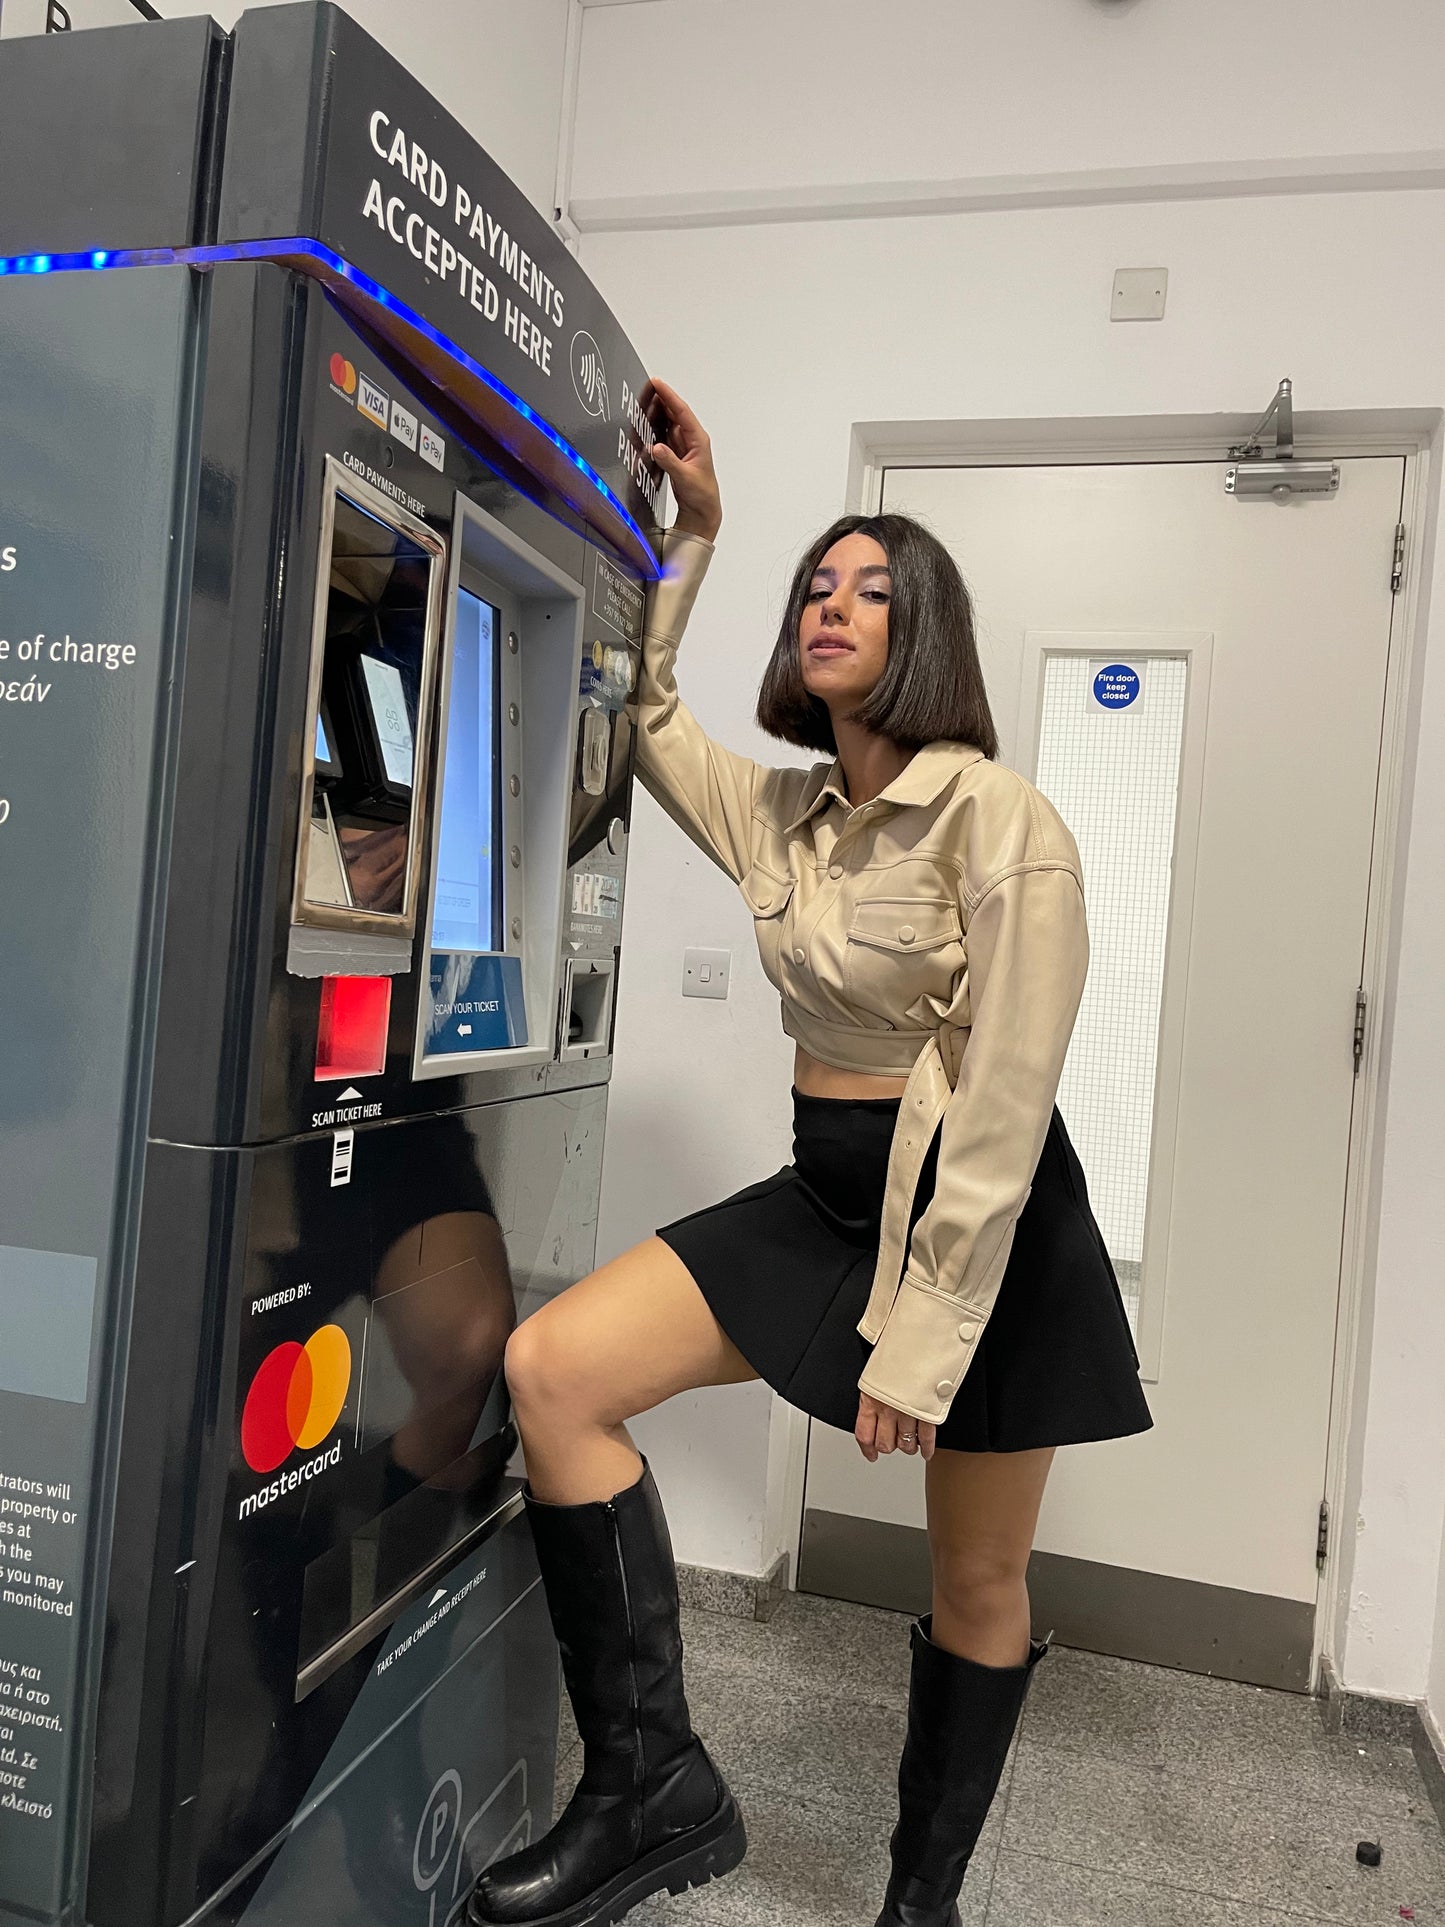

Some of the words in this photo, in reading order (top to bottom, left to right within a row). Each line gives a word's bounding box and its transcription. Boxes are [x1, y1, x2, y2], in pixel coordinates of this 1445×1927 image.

[369, 110, 448, 207] CARD
[454, 184, 564, 327] PAYMENTS
[362, 178, 499, 322] ACCEPTED
[504, 298, 552, 377] HERE
[363, 387, 385, 418] VISA
[400, 417, 415, 440] Pay
[618, 427, 637, 476] PAY
[343, 451, 365, 476] CARD
[366, 467, 407, 504] PAYMENTS
[407, 495, 426, 518] HERE
[18, 634, 45, 660] of
[50, 635, 137, 670] charge
[1098, 674, 1114, 682] Fire
[1116, 674, 1136, 682] door
[1106, 683, 1127, 692] keep
[1102, 692, 1130, 700] closed
[434, 1003, 452, 1015] SCAN
[453, 1002, 473, 1014] YOUR
[473, 1000, 499, 1012] TICKET
[312, 1112, 334, 1127] SCAN
[336, 1106, 362, 1122] TICKET
[363, 1102, 383, 1117] HERE
[251, 1287, 296, 1316] POWERED
[297, 1282, 312, 1299] BY:
[46, 1483, 71, 1501] will
[239, 1438, 342, 1521] mastercard
[1, 1498, 59, 1525] property
[62, 1511, 78, 1525] or
[17, 1524, 31, 1539] at
[10, 1542, 32, 1562] the
[7, 1567, 31, 1584] you
[35, 1574, 64, 1595] may
[3, 1589, 74, 1617] monitored
[377, 1652, 394, 1676] TAKE
[395, 1635, 413, 1660] YOUR
[412, 1612, 438, 1643] CHANGE
[437, 1601, 451, 1620] AND
[451, 1580, 473, 1609] RECEIPT
[473, 1568, 487, 1588] HERE
[20, 1664, 41, 1681] και
[26, 1689, 50, 1706] στο
